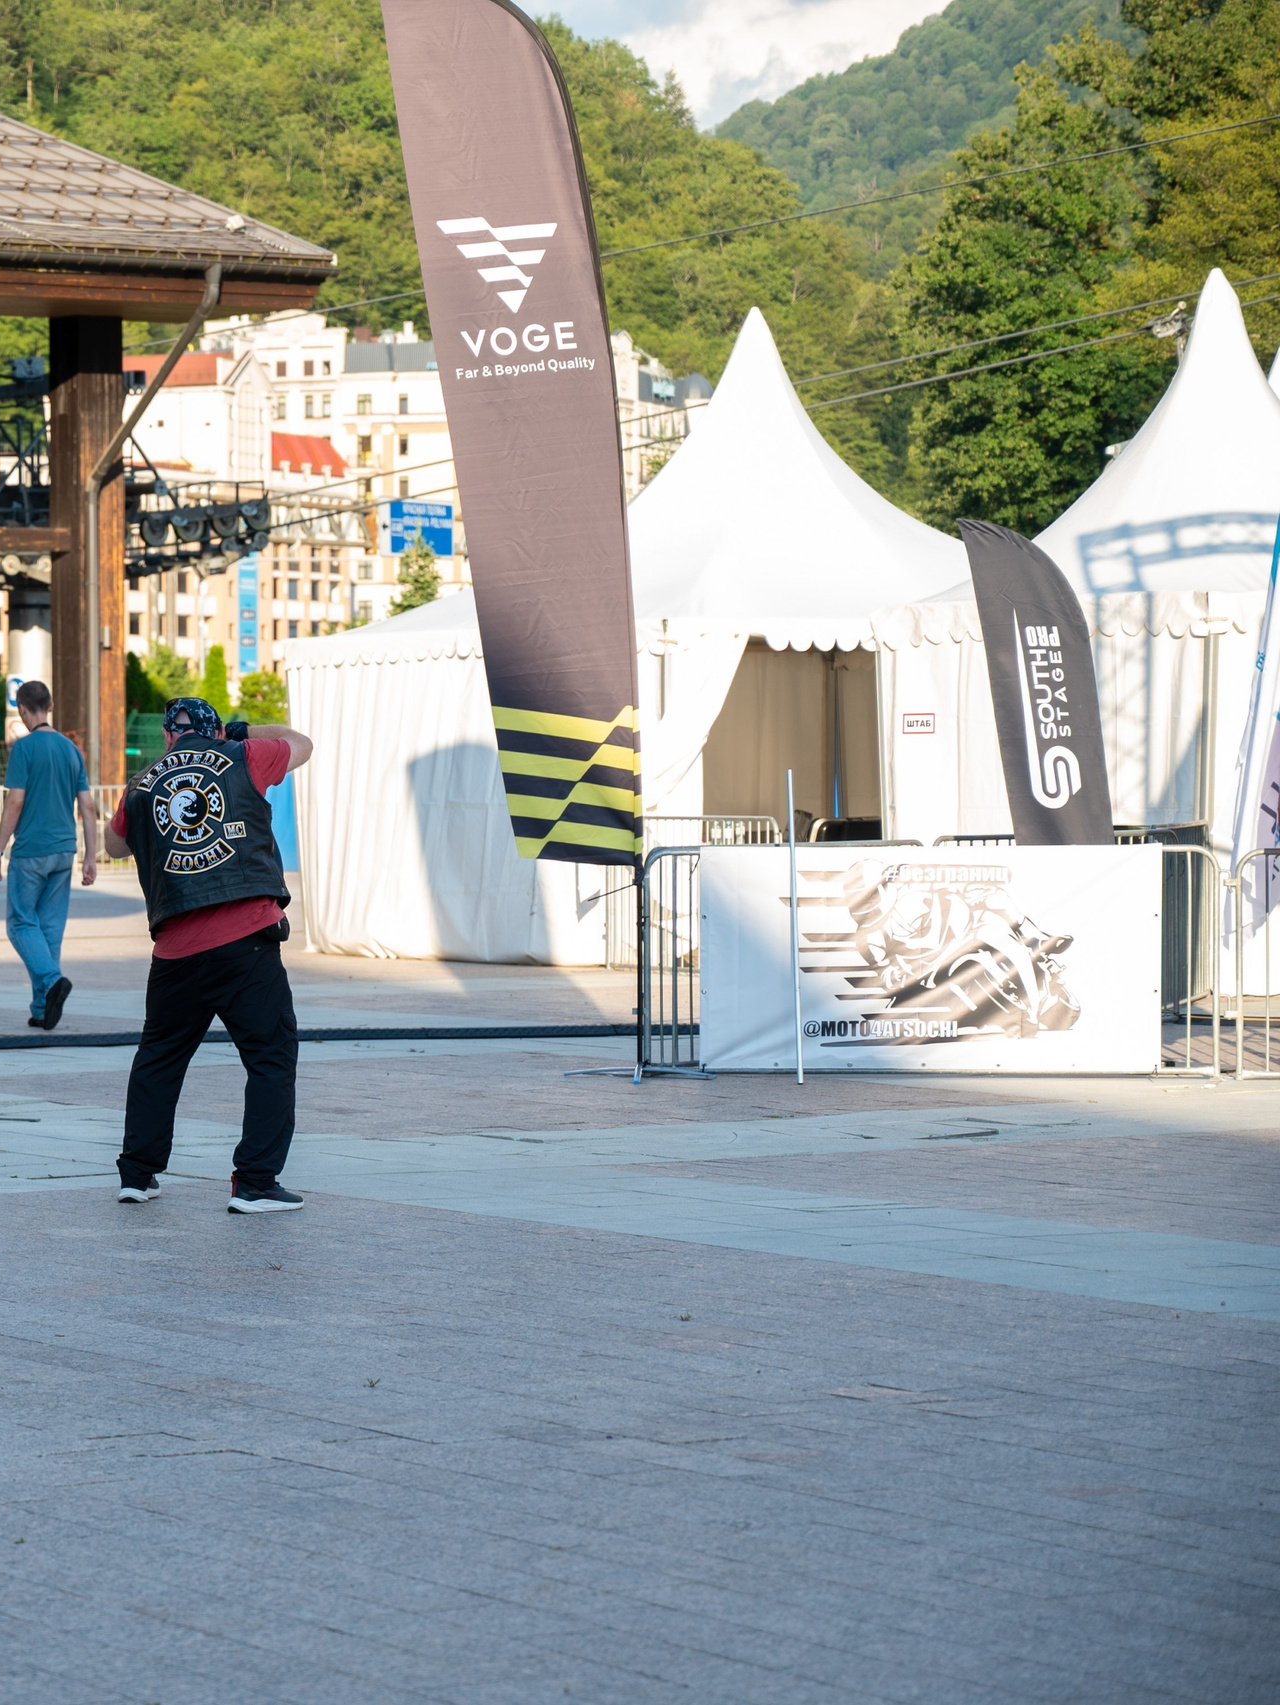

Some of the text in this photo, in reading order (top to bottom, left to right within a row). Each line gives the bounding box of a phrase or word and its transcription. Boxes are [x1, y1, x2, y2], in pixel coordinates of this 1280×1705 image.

[460, 321, 578, 358] VOGE
[455, 357, 596, 380] Far & Beyond Quality
[1025, 625, 1061, 647] PRO
[1029, 648, 1058, 739] SOUTH
[1049, 650, 1072, 737] STAGE
[906, 719, 931, 728] ШТАБ
[141, 752, 225, 788] MEDVEDI
[226, 824, 243, 836] MC
[171, 843, 227, 871] SOCHI
